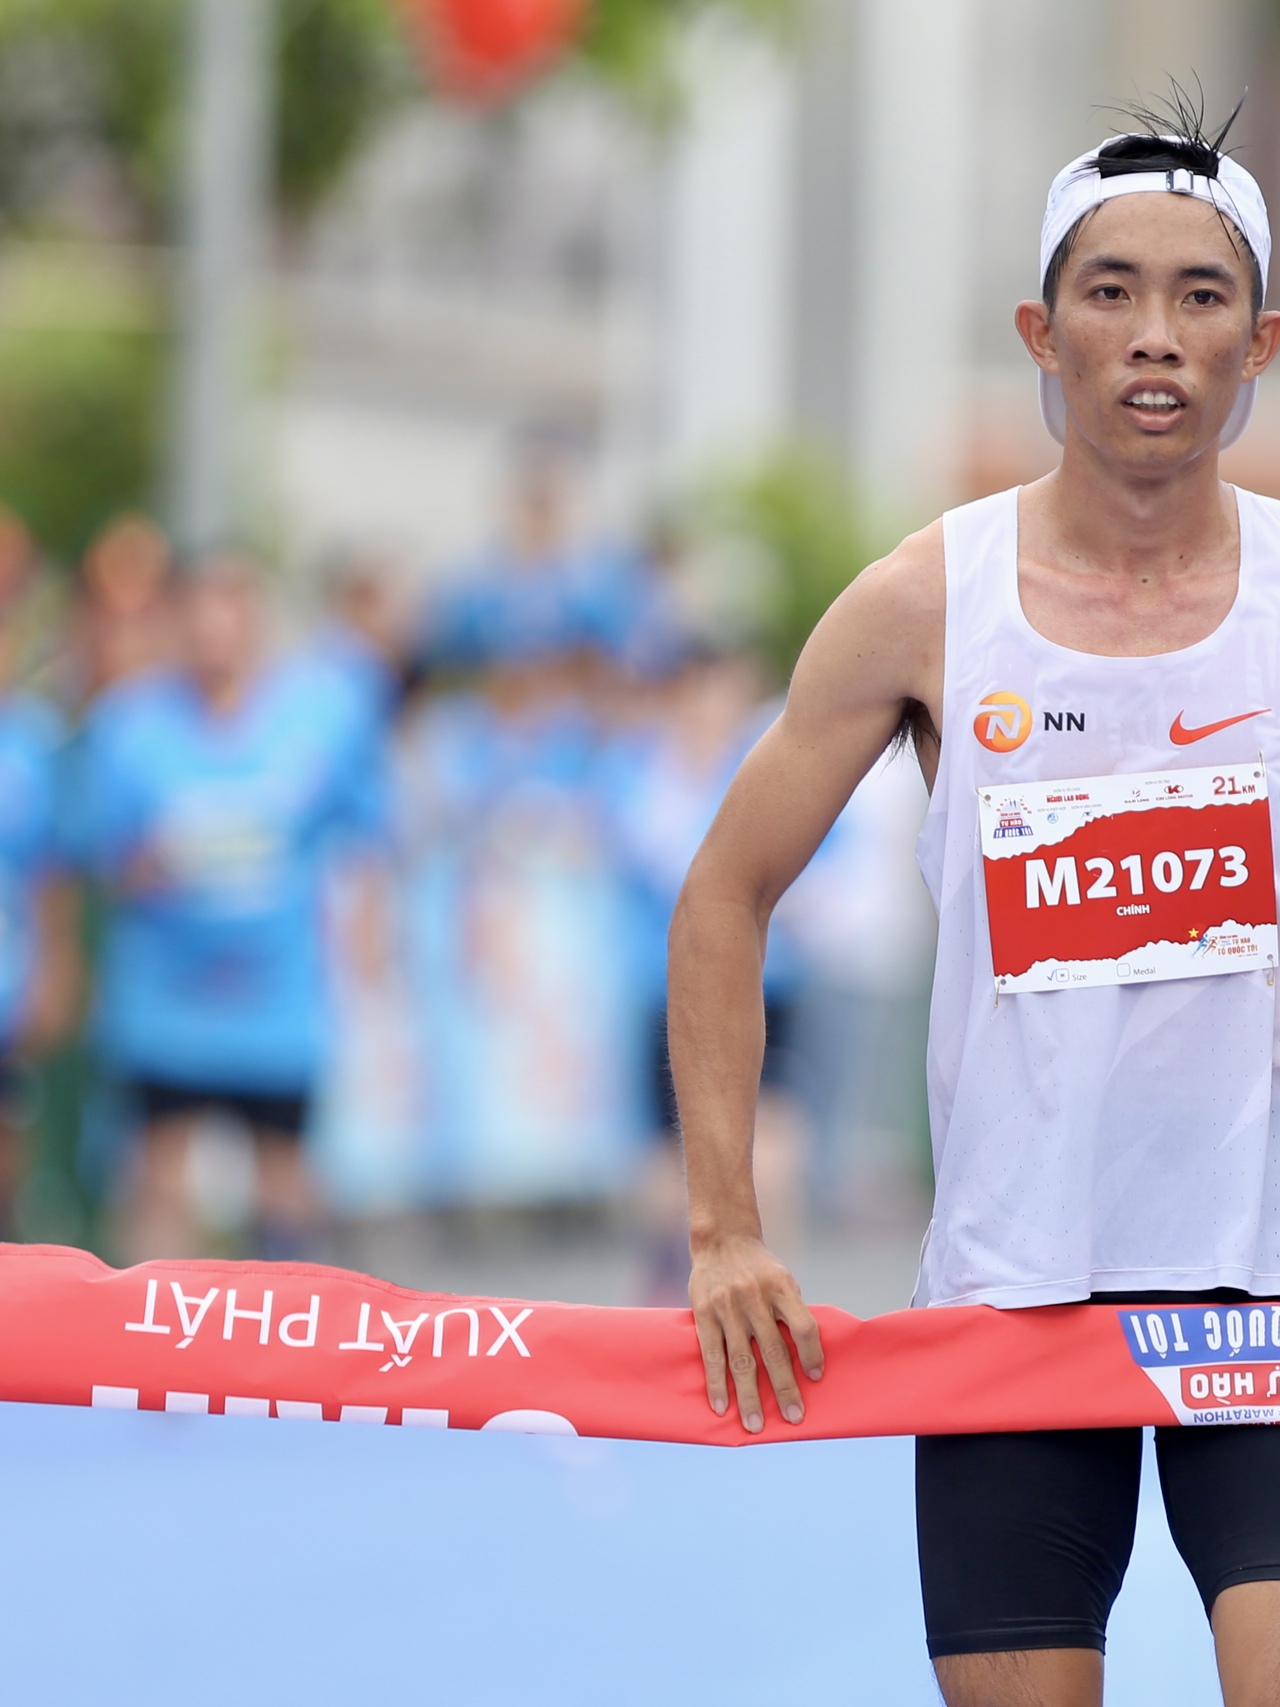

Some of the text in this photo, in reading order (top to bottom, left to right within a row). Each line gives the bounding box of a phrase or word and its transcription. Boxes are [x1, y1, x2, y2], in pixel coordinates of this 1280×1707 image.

[1043, 711, 1085, 732] NN
[1025, 845, 1249, 909] M21073
[1116, 903, 1151, 916] CHÍNH
[1072, 973, 1087, 981] Size
[1133, 966, 1156, 976] Medal
[125, 1279, 534, 1372] XUẤT PHÁT
[1129, 1312, 1190, 1359] TÔI
[1189, 1370, 1255, 1405] HÀO
[1193, 1408, 1274, 1424] MARATHON
